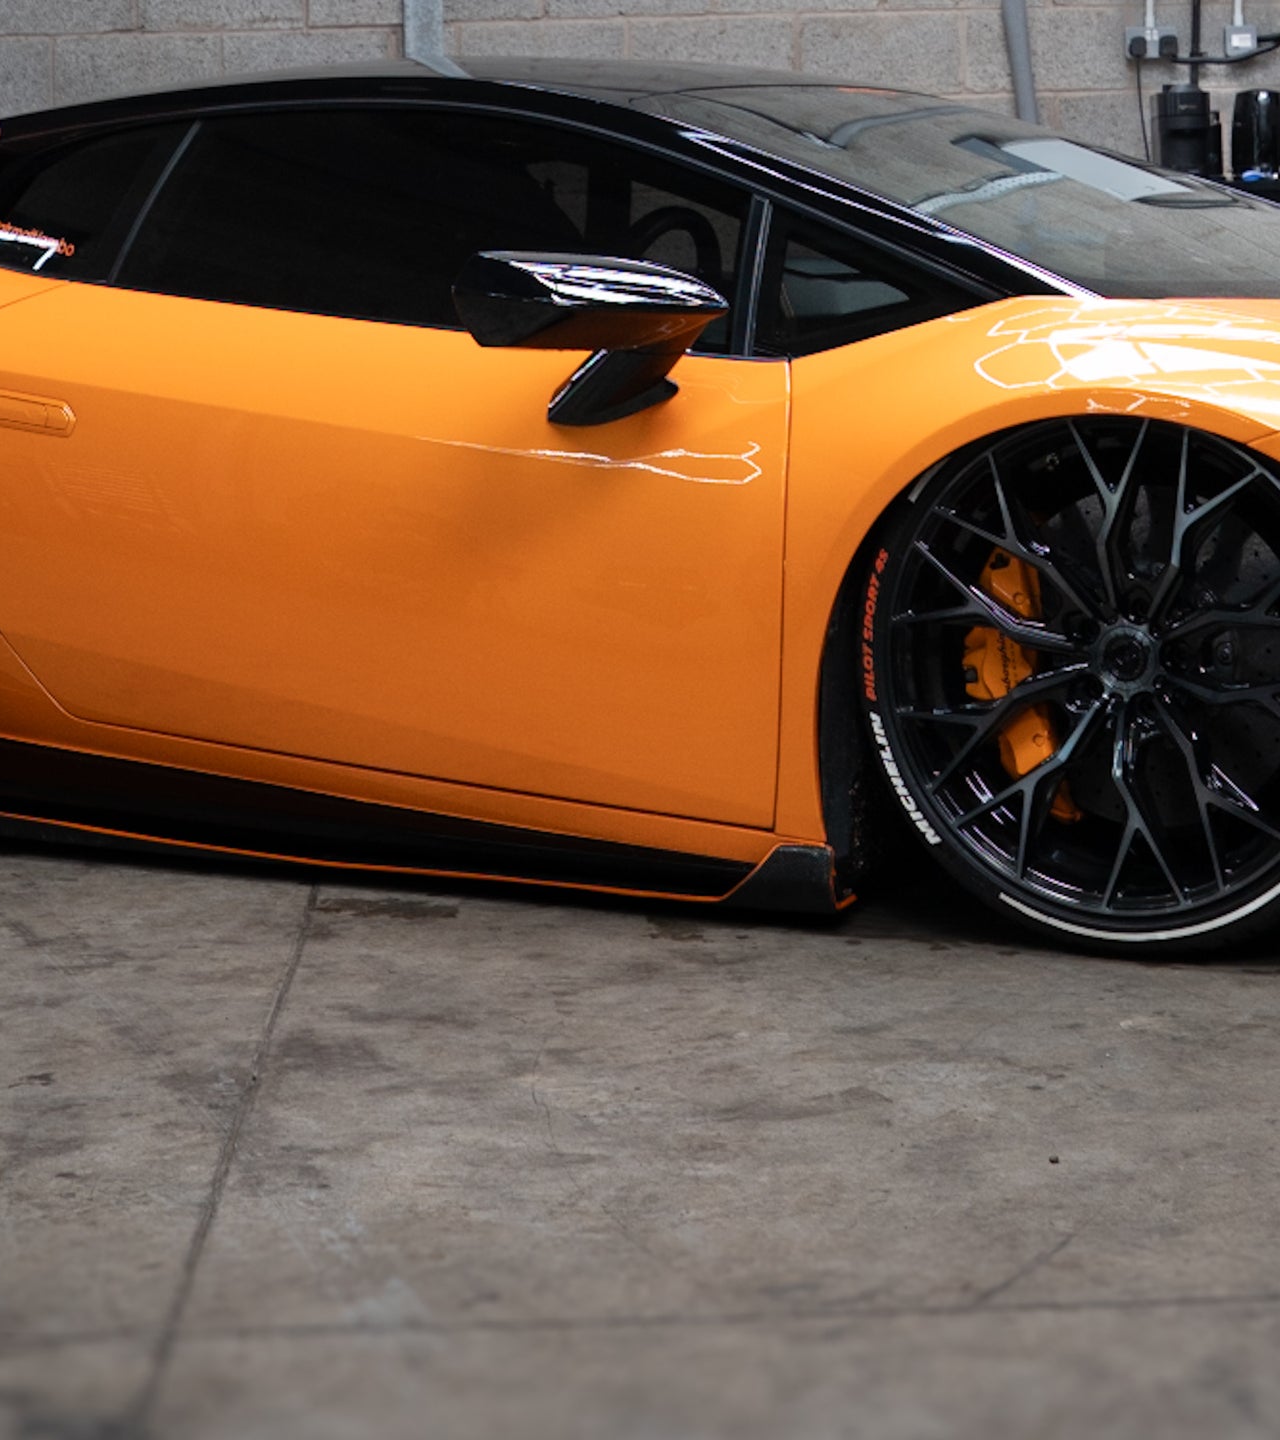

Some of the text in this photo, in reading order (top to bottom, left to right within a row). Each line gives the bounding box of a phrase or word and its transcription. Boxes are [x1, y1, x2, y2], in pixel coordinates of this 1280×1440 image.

[862, 573, 880, 640] SPORT
[862, 644, 878, 702] PILOT
[869, 711, 942, 847] MICHELIN
